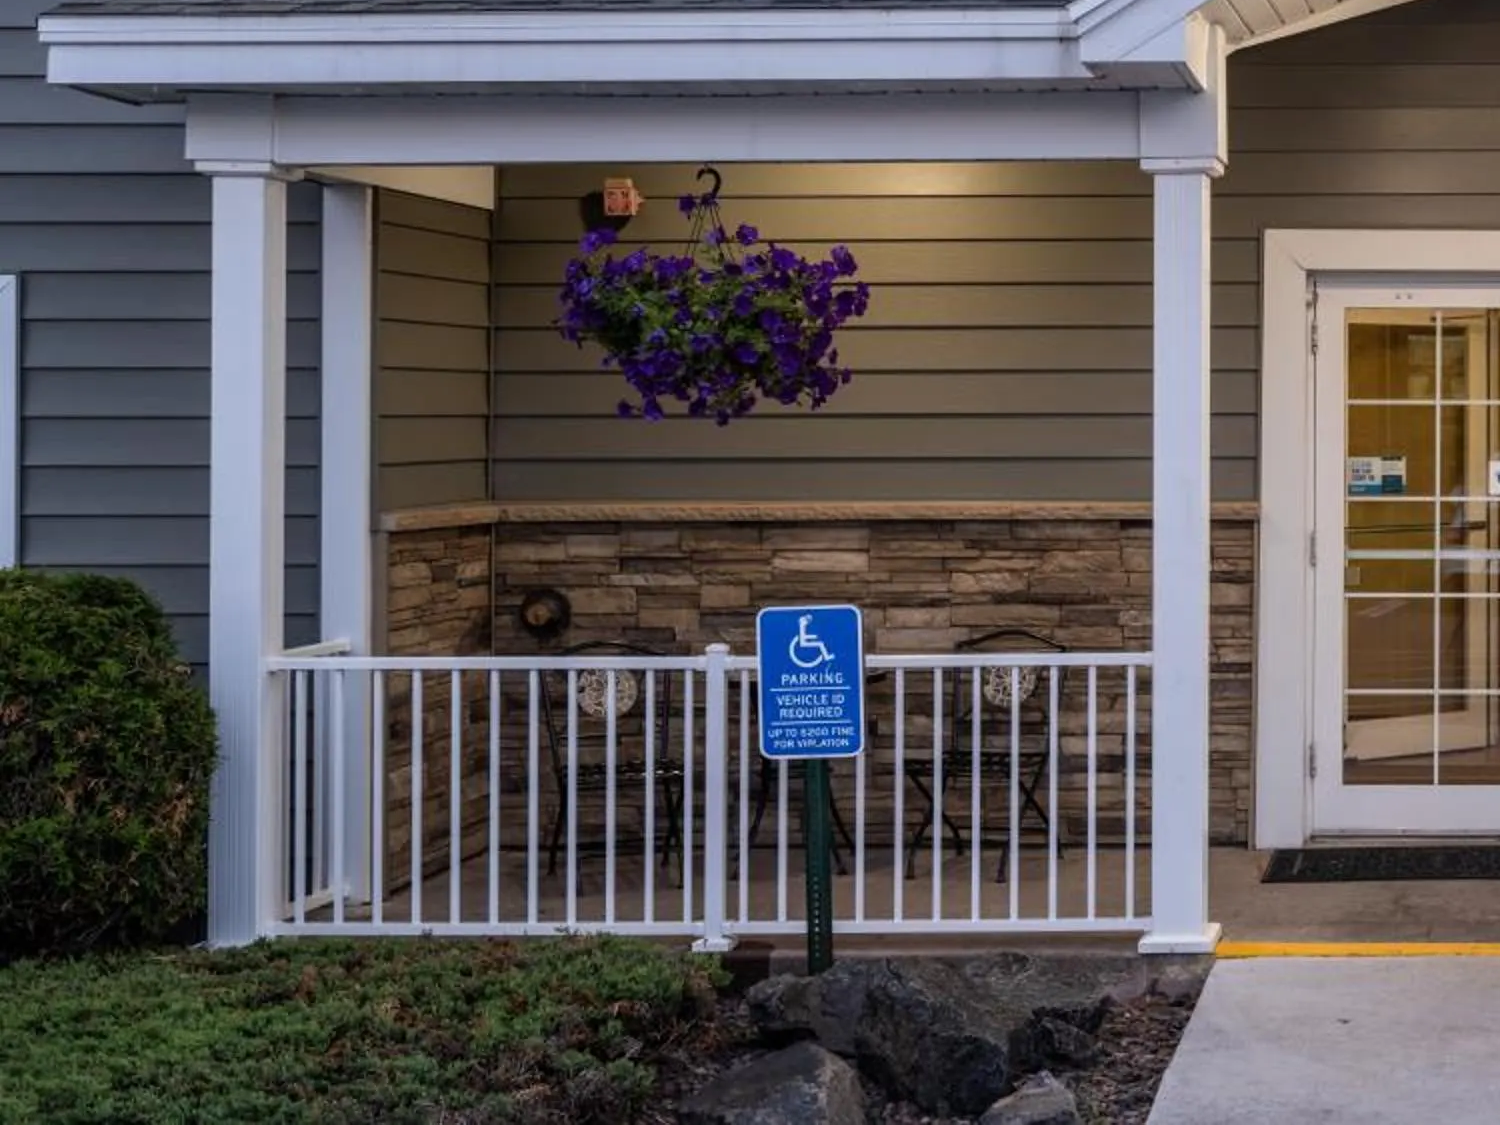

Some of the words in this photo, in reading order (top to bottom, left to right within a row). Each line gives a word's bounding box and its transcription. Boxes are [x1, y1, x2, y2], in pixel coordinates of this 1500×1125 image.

[781, 673, 844, 686] PARKING
[776, 694, 829, 706] VEHICLE
[832, 694, 845, 704] ID
[779, 706, 843, 719] REQUIRED
[767, 730, 783, 738] UP
[785, 729, 797, 738] TO
[831, 726, 855, 736] FINE
[773, 739, 795, 749] FOR
